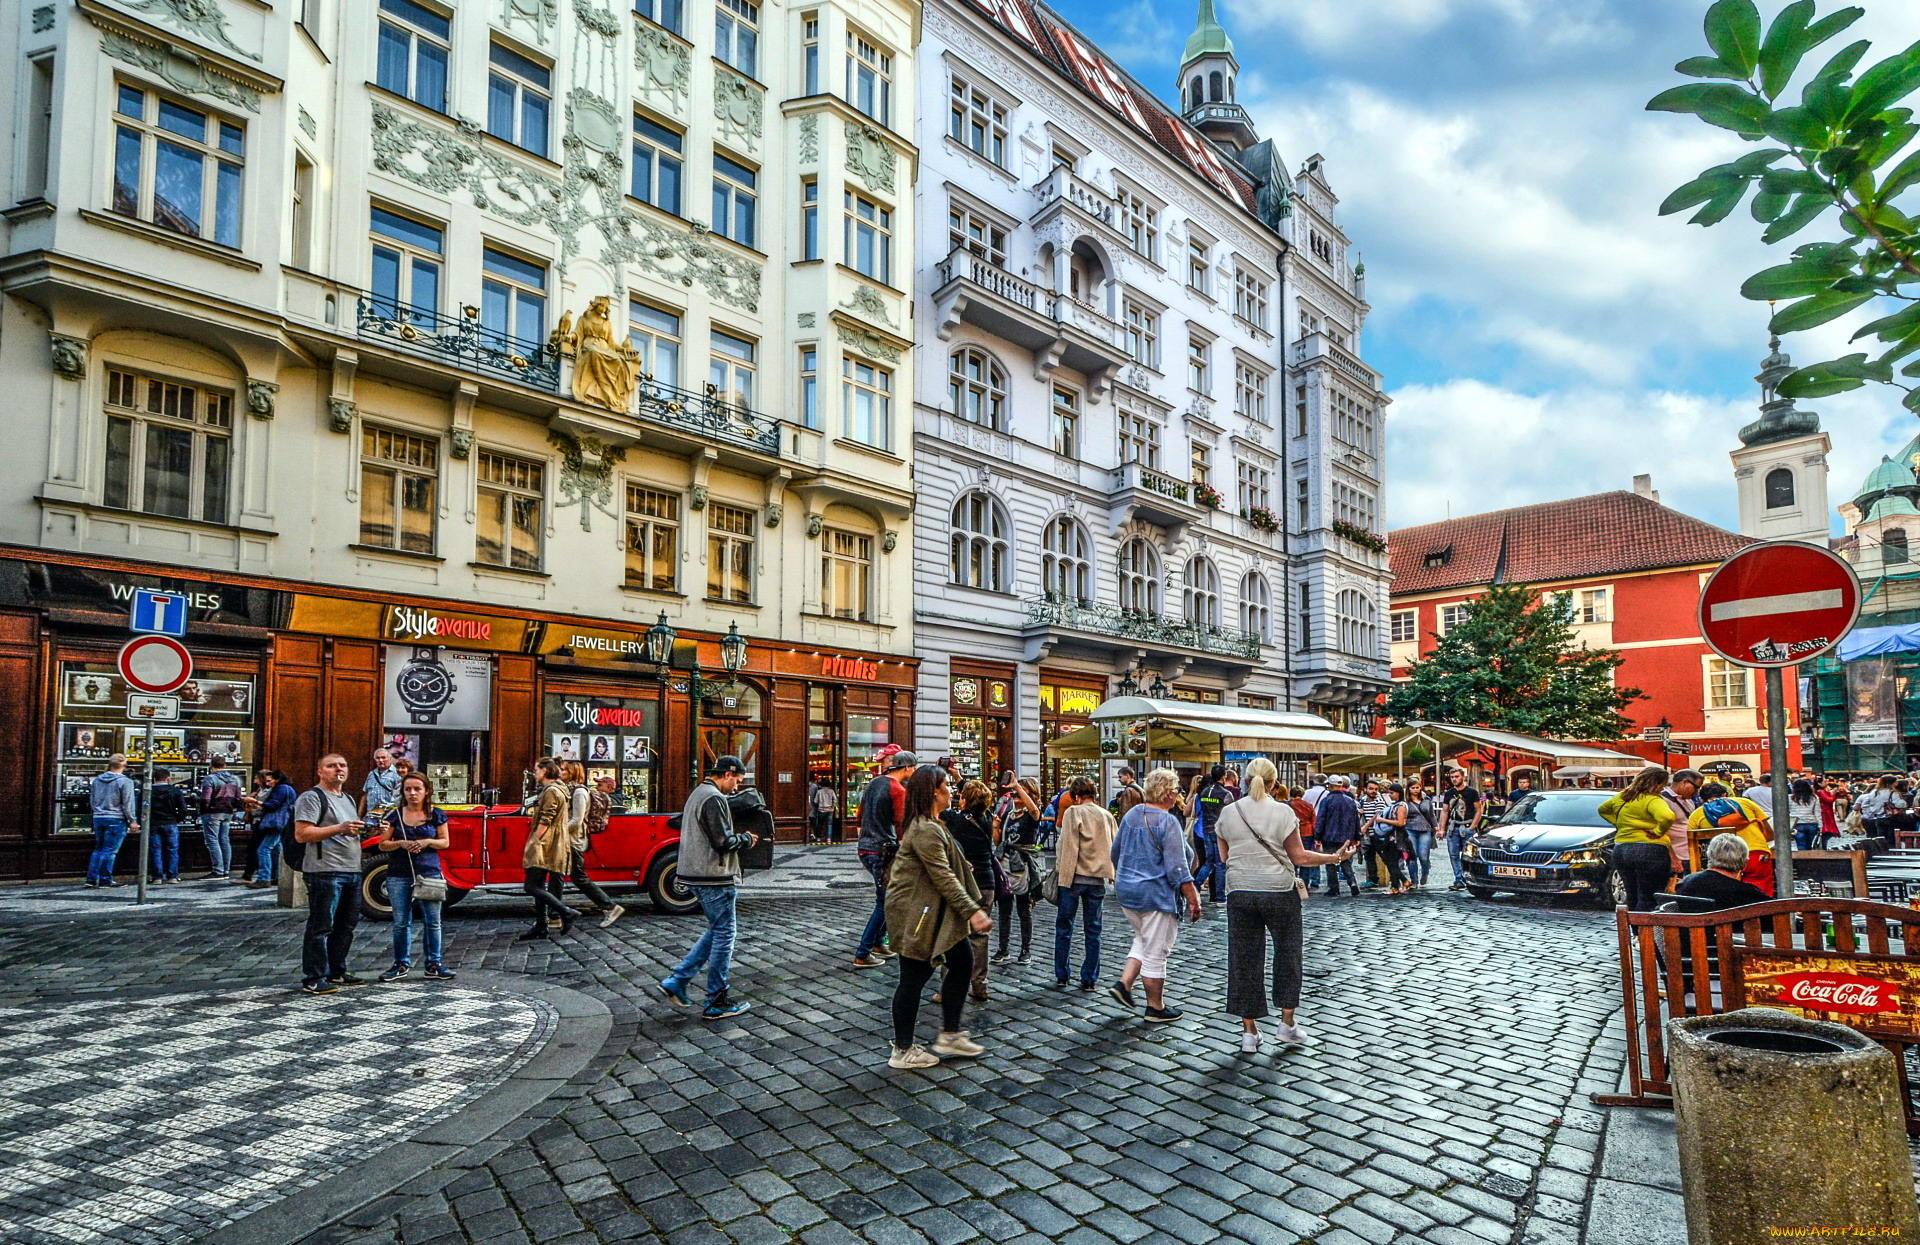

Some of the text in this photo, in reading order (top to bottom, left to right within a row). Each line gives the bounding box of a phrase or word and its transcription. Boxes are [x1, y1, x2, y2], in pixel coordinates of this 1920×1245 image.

[110, 583, 220, 610] WHES
[569, 634, 645, 654] JEWELLERY
[821, 657, 878, 680] PYLONES
[1061, 690, 1100, 708] MARKET
[1494, 866, 1532, 876] 5AR 5141
[1791, 980, 1880, 1007] Coca-Cola
